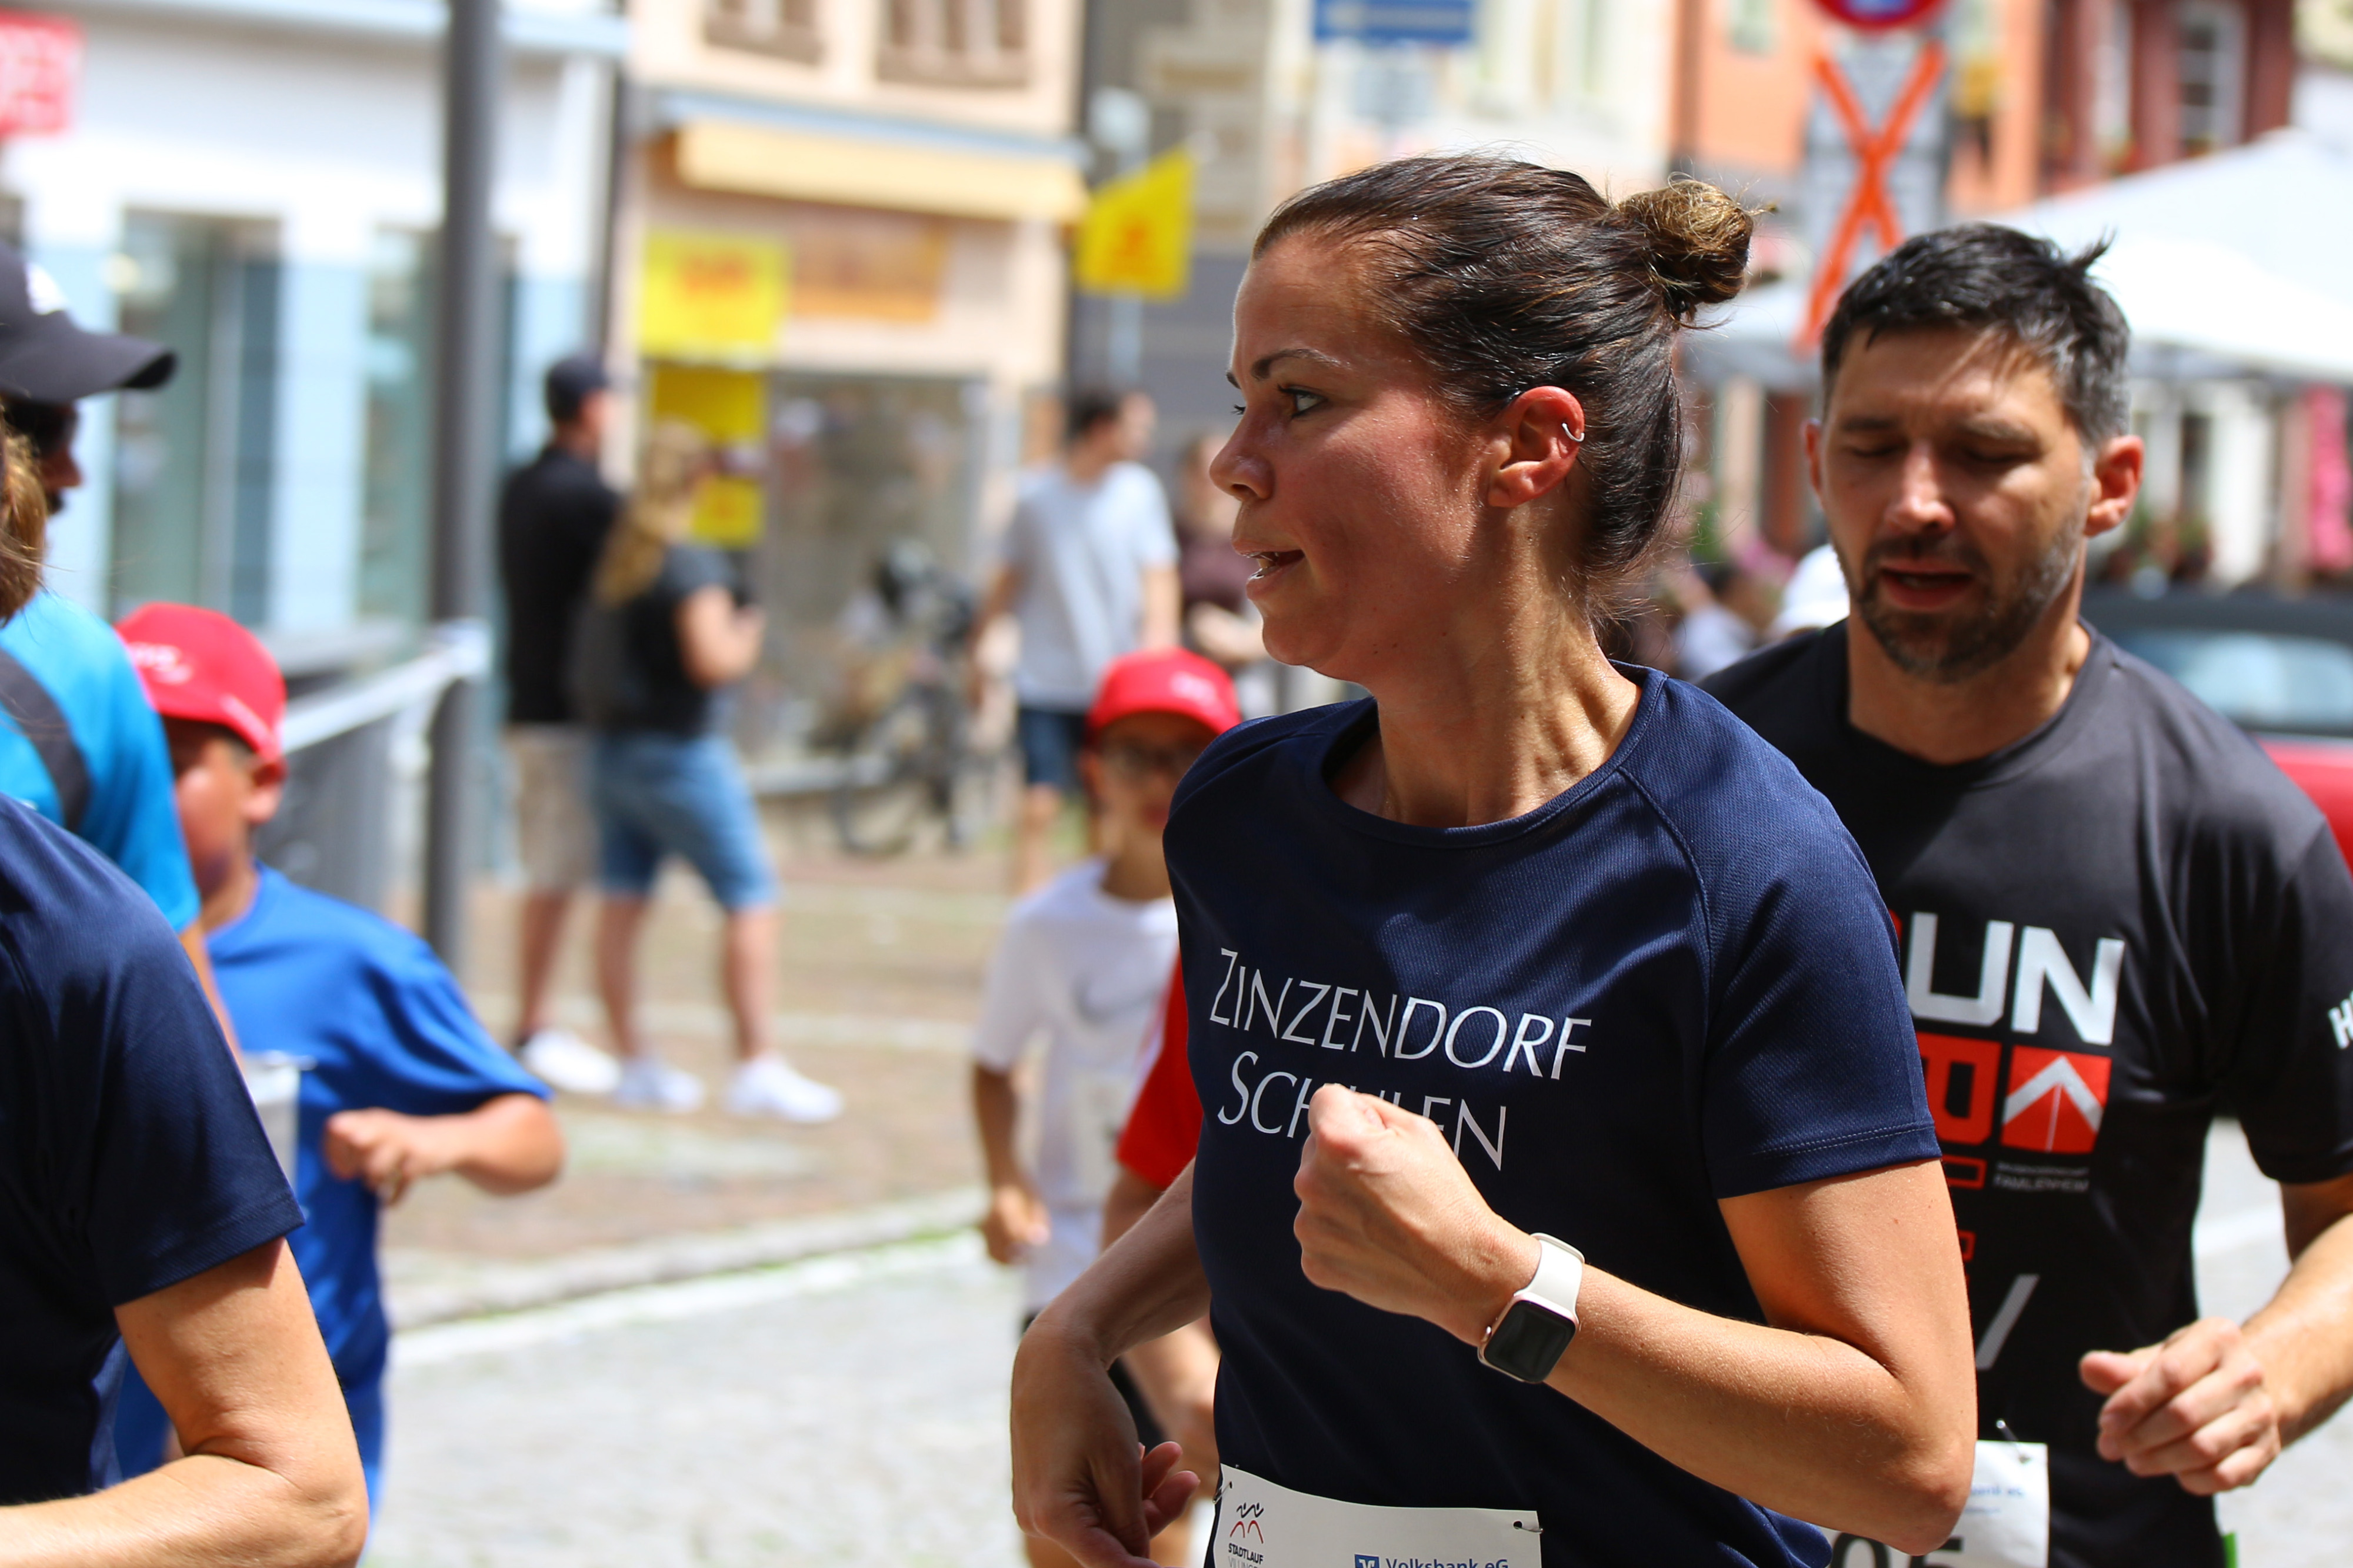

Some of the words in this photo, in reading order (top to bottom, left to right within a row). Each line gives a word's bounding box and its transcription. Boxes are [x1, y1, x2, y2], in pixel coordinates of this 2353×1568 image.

[1209, 947, 1592, 1080] ZINZENDORF
[1887, 909, 2125, 1046] UN
[1217, 1050, 1507, 1171] SCHEN
[1228, 1543, 1264, 1565] STADTLAUF
[1385, 1558, 1478, 1568] Volksbank
